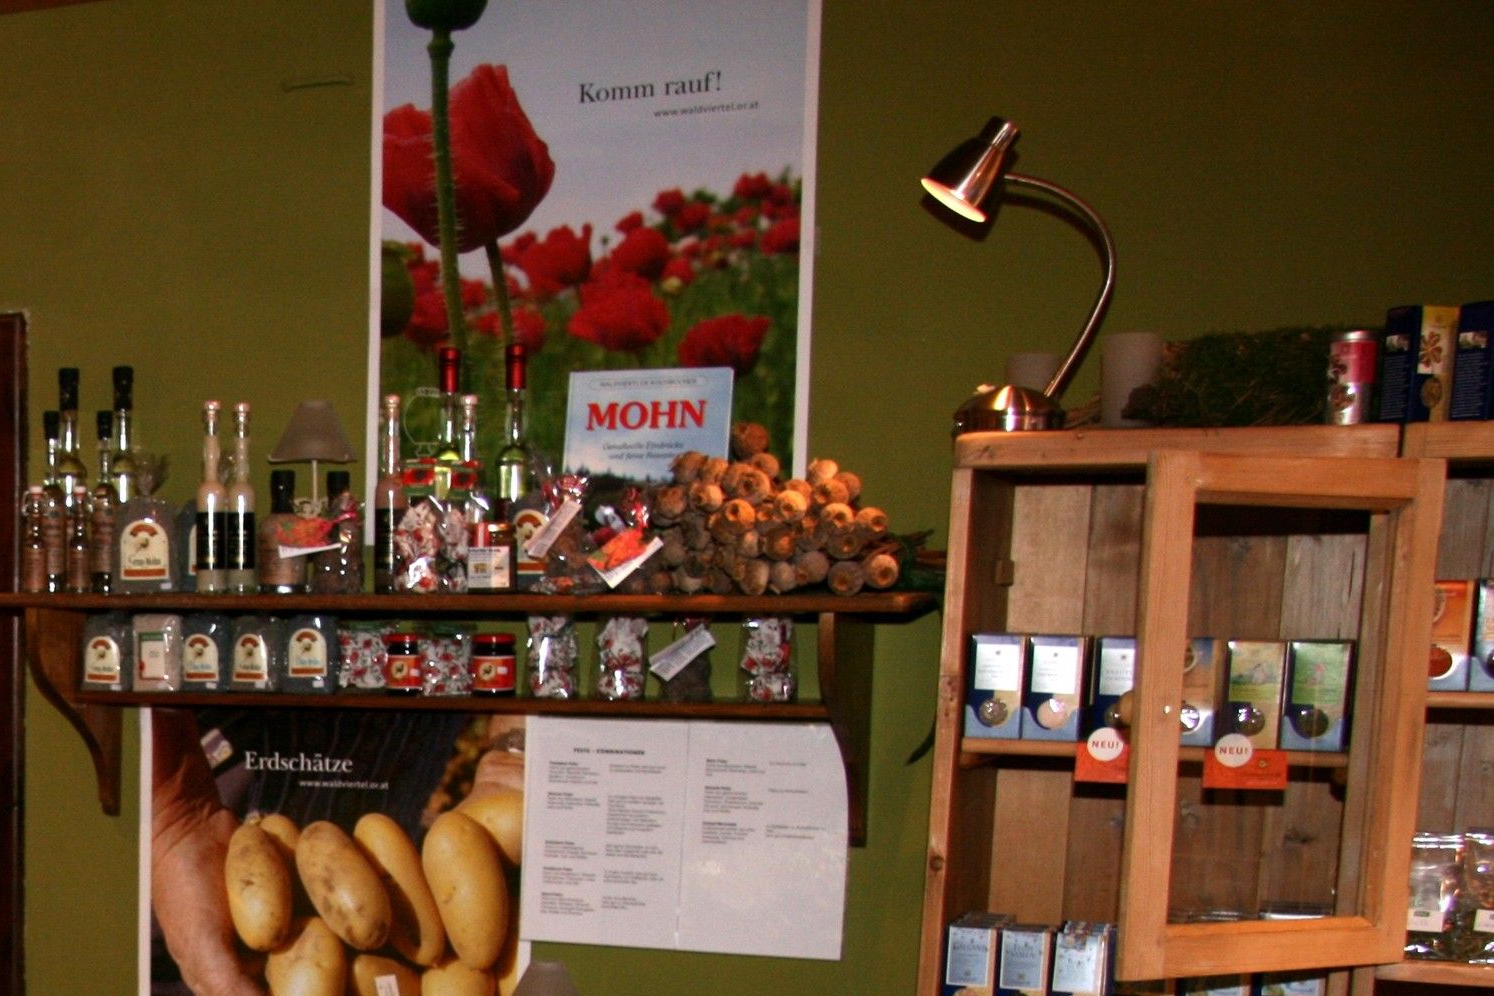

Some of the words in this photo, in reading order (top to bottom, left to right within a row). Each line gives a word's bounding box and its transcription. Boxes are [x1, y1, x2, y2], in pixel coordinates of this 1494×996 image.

[578, 82, 655, 104] Komm
[664, 70, 722, 97] rauf!
[653, 101, 760, 118] www.waldviertel.or.at
[586, 399, 707, 432] MOHN
[1091, 740, 1120, 750] NEU!
[1218, 746, 1249, 755] NEU!
[244, 751, 354, 773] Erdschätze
